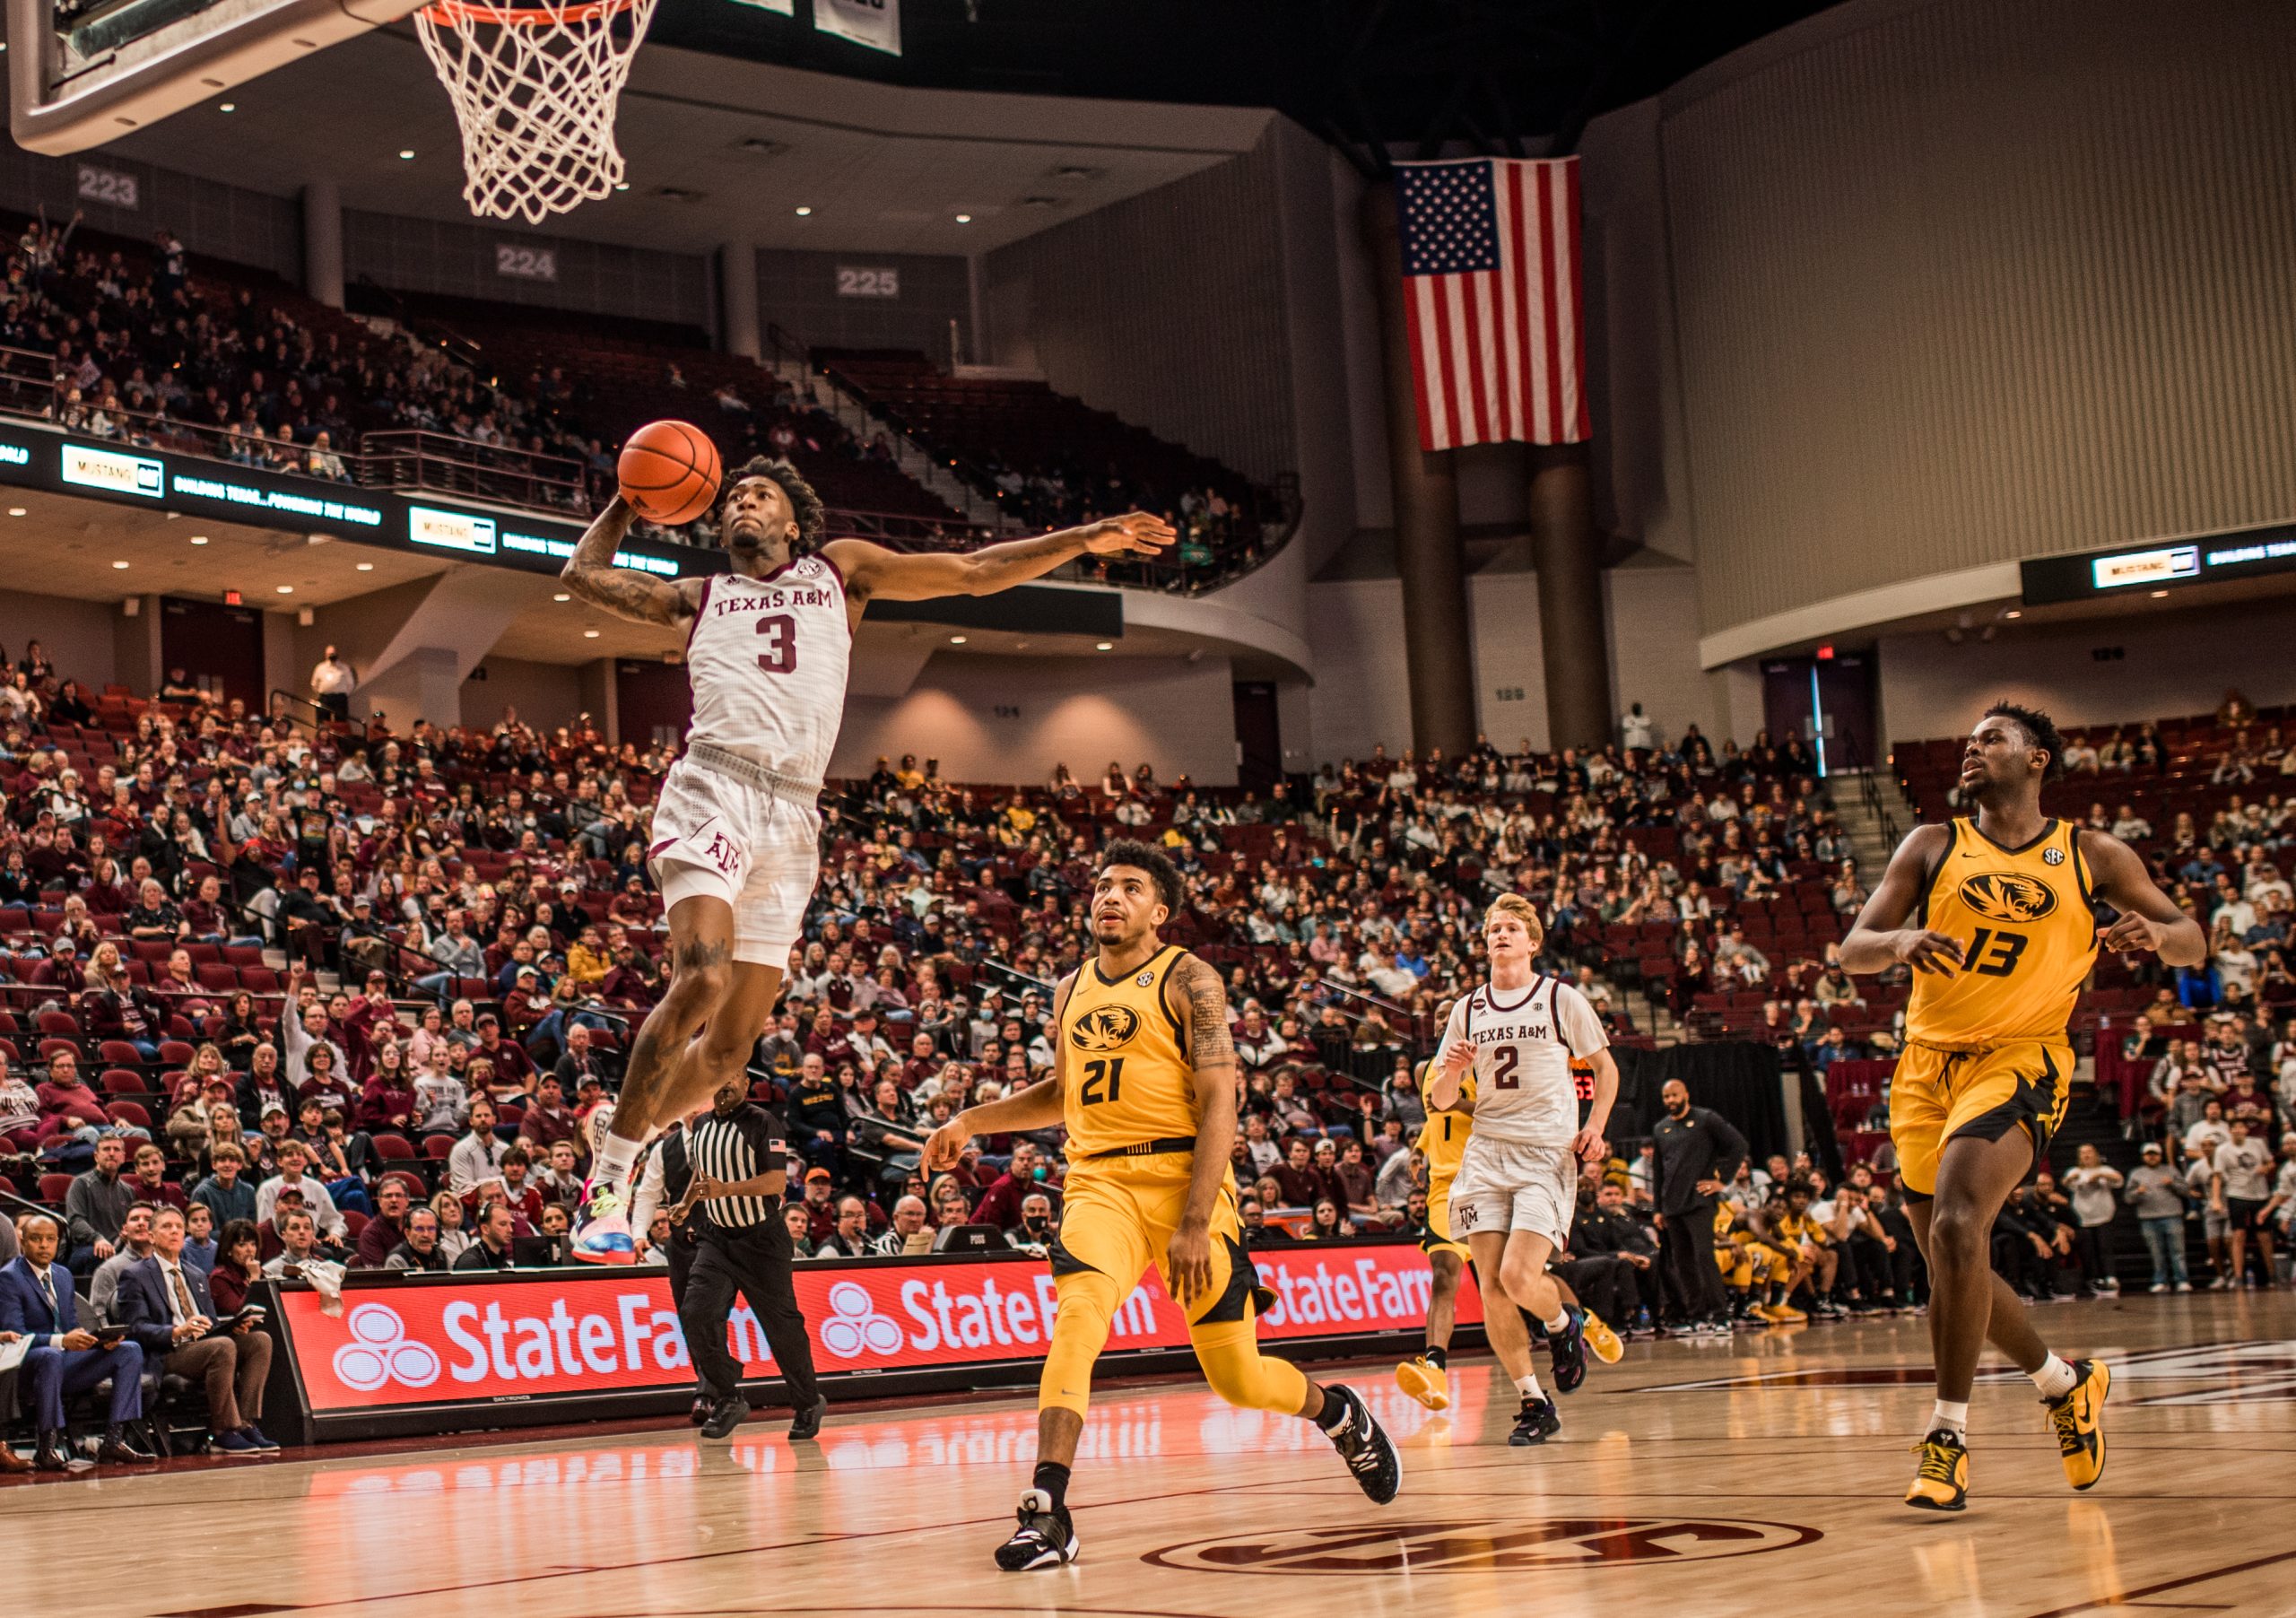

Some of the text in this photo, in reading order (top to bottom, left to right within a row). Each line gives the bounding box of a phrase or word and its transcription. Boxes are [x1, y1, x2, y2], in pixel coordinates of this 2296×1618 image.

[78, 170, 136, 206] 223
[498, 248, 555, 278] 224
[838, 270, 898, 296] 225
[77, 460, 132, 482] MUSTANG
[2111, 561, 2165, 576] MUSTANG
[715, 587, 832, 617] TEXAS A&M
[756, 613, 797, 674] 3
[2045, 848, 2064, 866] SEC
[1961, 927, 2029, 978] 13
[1138, 972, 1153, 986] SEC
[1472, 1025, 1547, 1045] TEXAS A&M
[1081, 1057, 1125, 1107] 21
[1494, 1046, 1519, 1090] 2
[1443, 1115, 1451, 1142] 1
